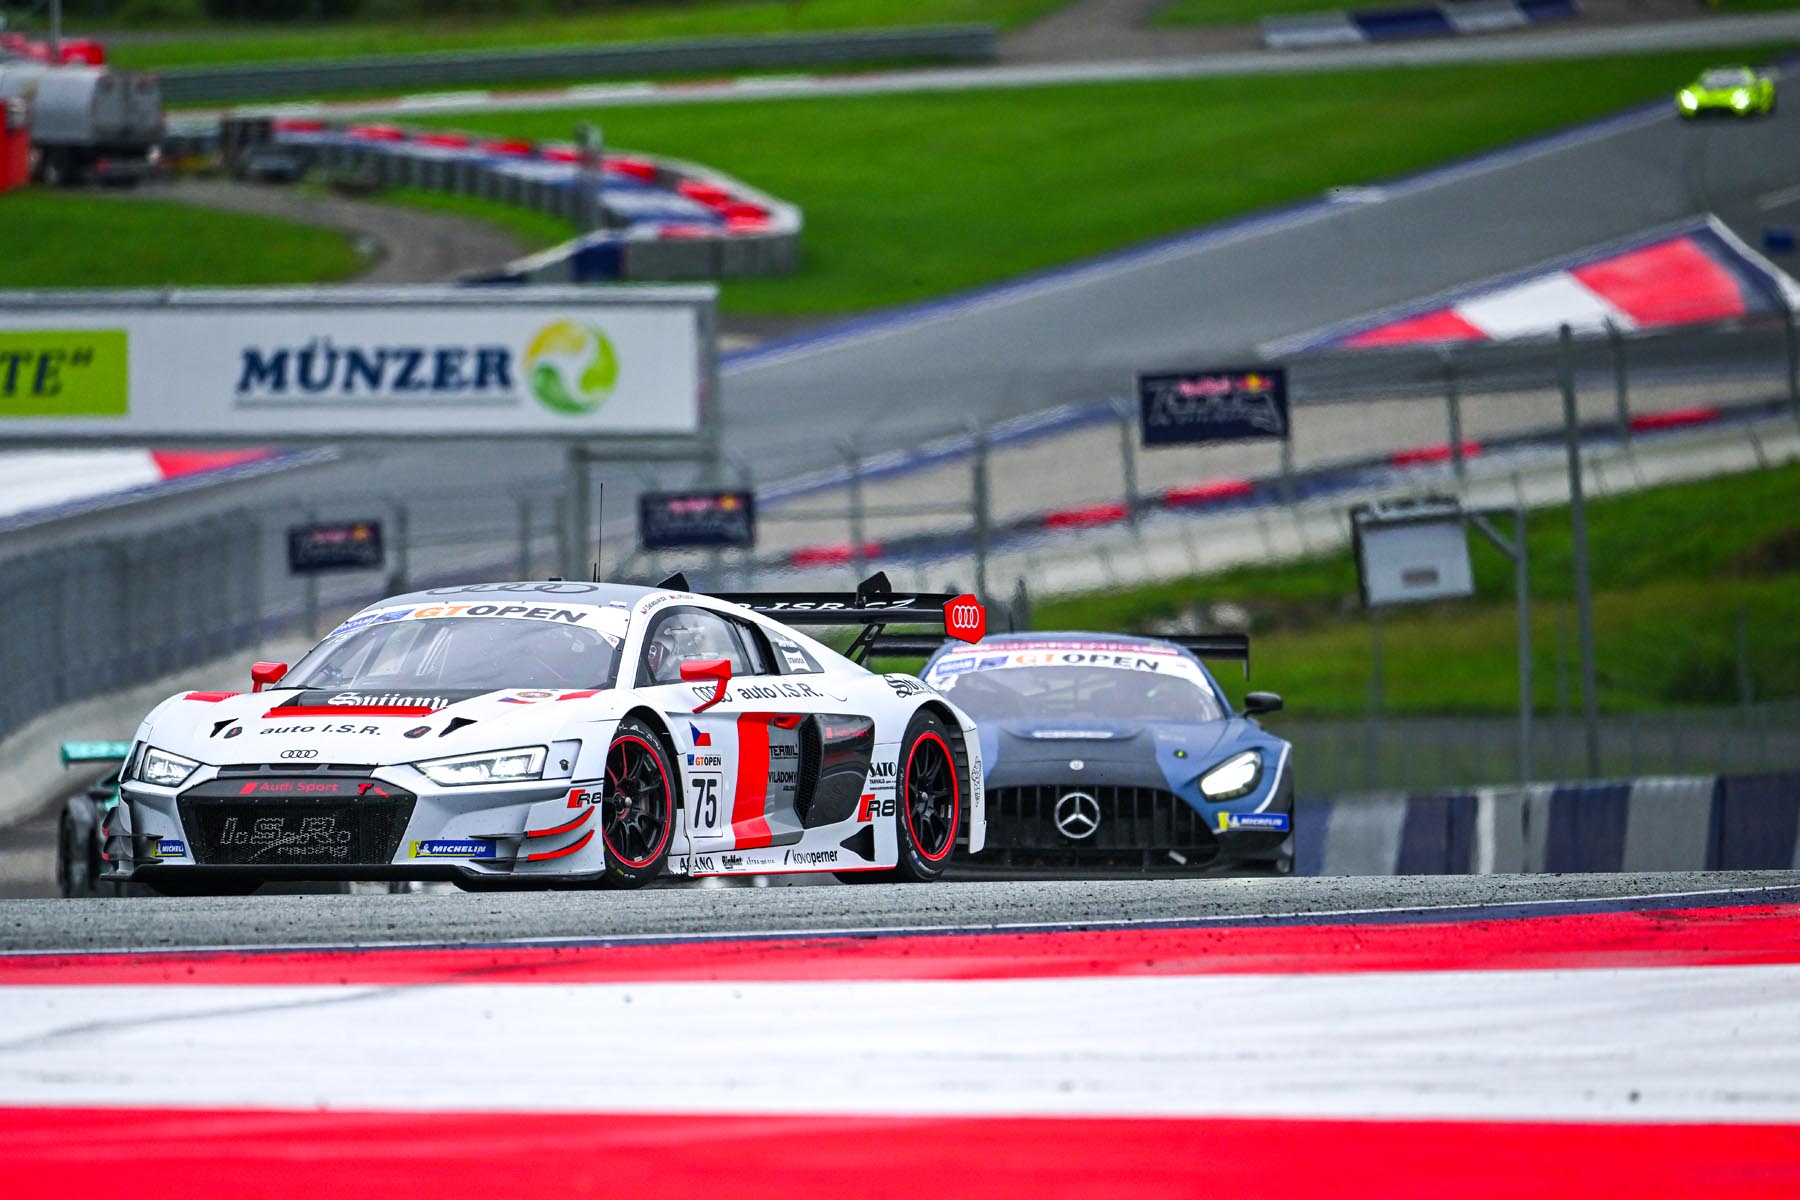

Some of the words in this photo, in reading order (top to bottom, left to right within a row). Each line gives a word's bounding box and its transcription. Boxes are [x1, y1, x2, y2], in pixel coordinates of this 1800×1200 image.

[237, 335, 514, 393] MÜNZER
[738, 684, 776, 701] auto
[776, 682, 824, 698] I.S.R.
[259, 725, 315, 735] auto
[321, 724, 381, 736] I.S.R.
[695, 755, 722, 767] GTOPEN
[869, 762, 896, 777] SATO
[259, 783, 292, 792] Audi
[297, 783, 339, 793] Sport
[577, 792, 602, 805] R8
[692, 779, 718, 829] 75
[866, 800, 895, 817] R8
[432, 845, 487, 853] MICHELIN
[793, 850, 838, 866] kovoperner
